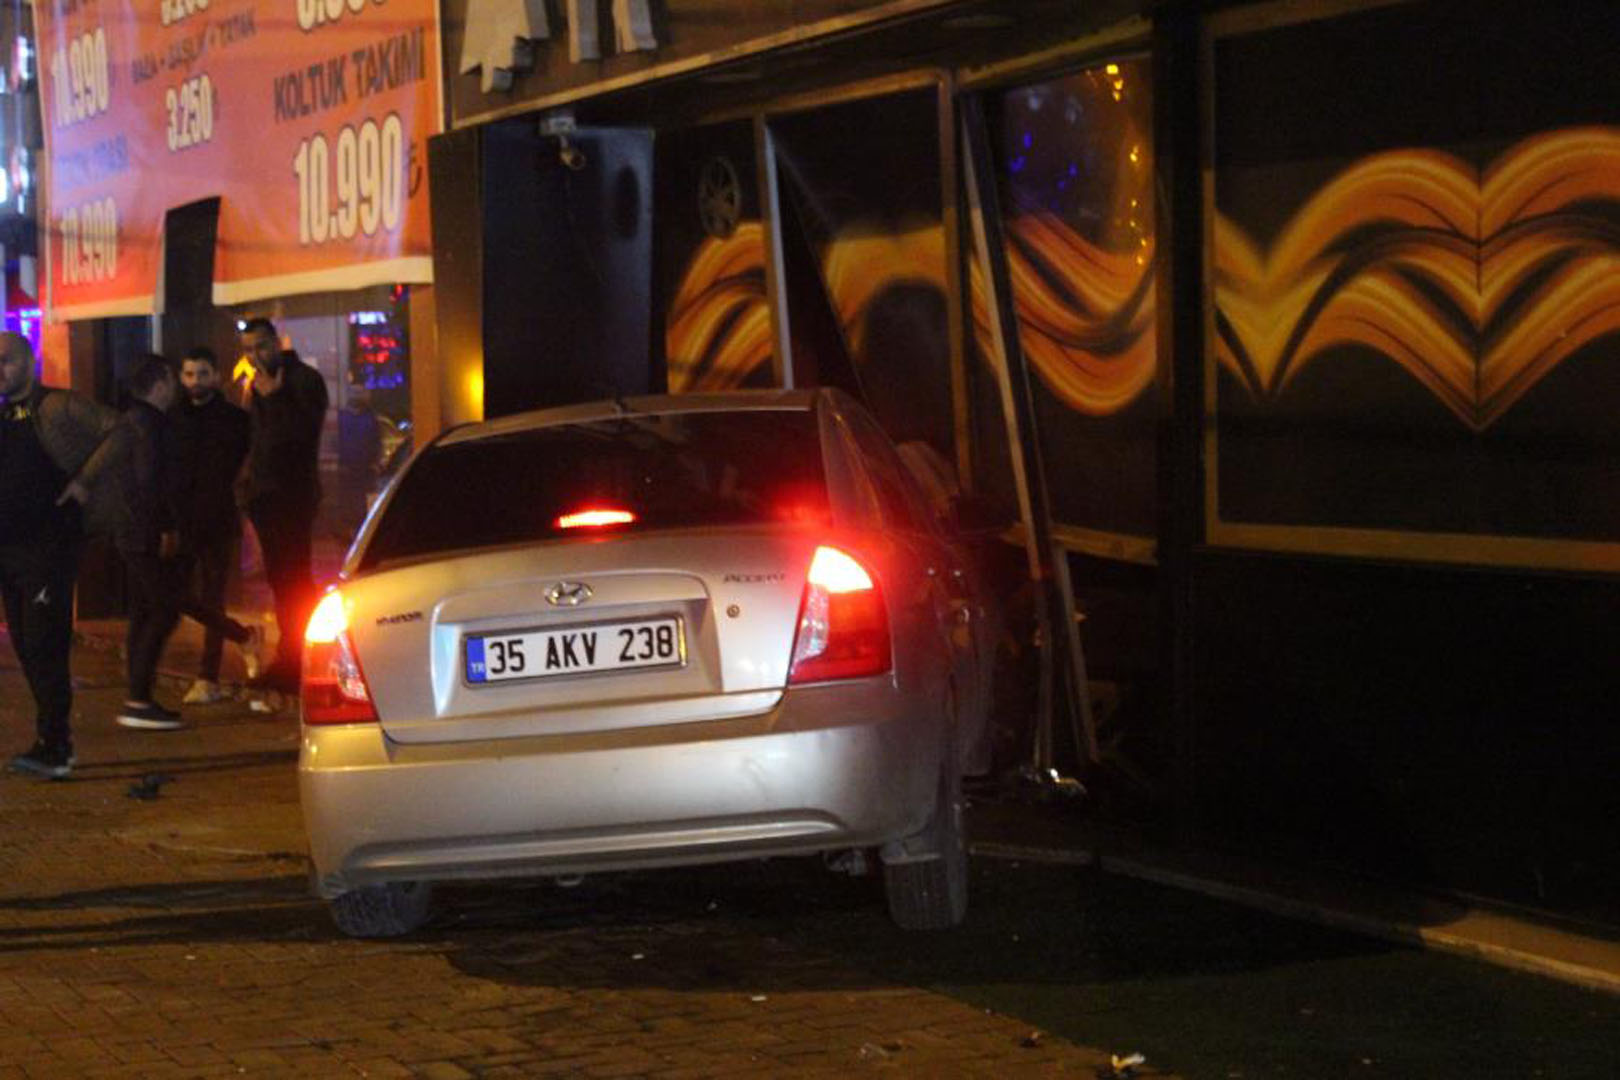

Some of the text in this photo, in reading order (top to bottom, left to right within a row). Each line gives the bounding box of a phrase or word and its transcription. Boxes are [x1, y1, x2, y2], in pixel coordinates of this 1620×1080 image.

[165, 74, 213, 152] 3.250
[274, 53, 347, 124] KOLTUK
[352, 26, 425, 98] TAKIMI
[294, 111, 402, 245] 10.990
[489, 639, 525, 674] 35
[546, 632, 597, 670] AKV
[618, 625, 674, 662] 238
